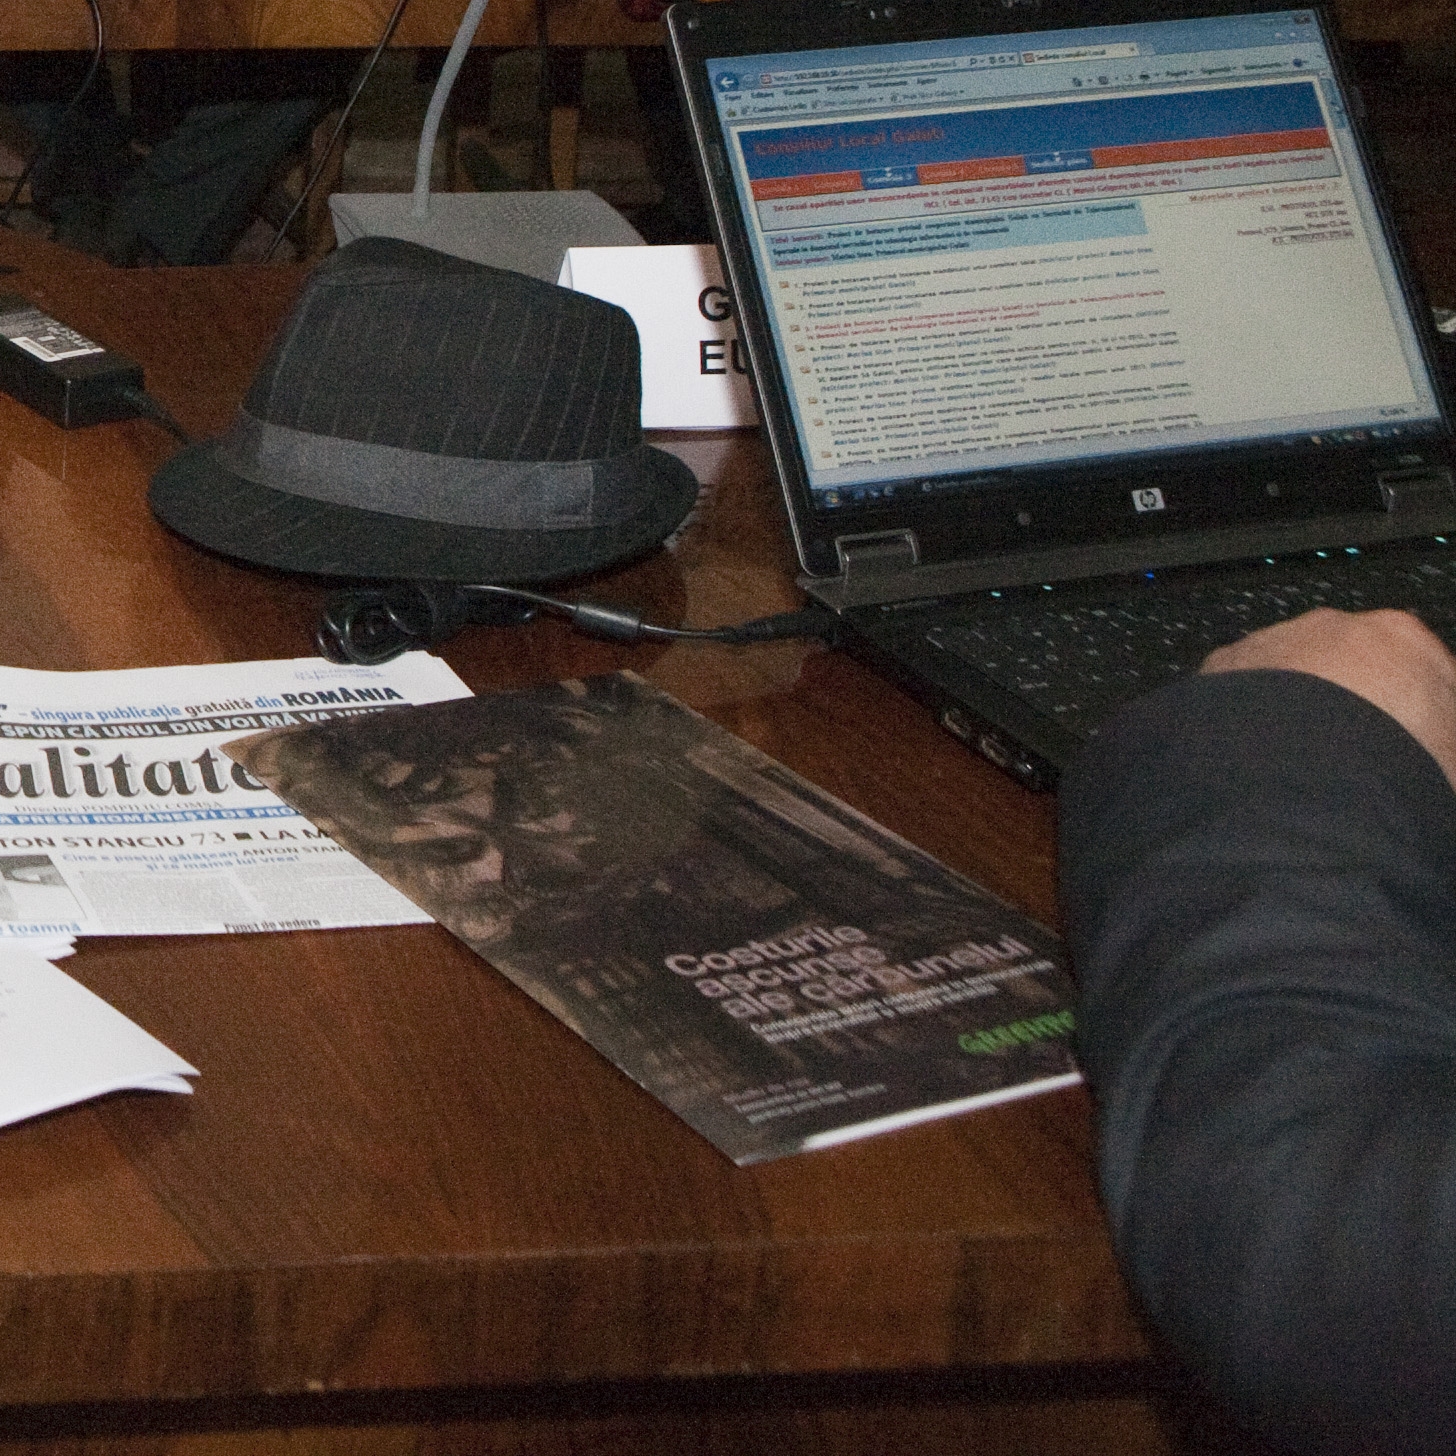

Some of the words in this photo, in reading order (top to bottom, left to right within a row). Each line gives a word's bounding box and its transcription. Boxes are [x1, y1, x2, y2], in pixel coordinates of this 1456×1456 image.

[31, 709, 93, 724] singura
[254, 695, 282, 709] din
[281, 686, 403, 707] ROMÂNIA
[3, 725, 64, 739] SPUN
[67, 722, 98, 739] CĂ
[101, 721, 168, 739] UNUL
[174, 718, 212, 735] DIN
[216, 713, 259, 731] VOI
[63, 835, 184, 849] STANCIU
[259, 829, 296, 841] LA
[242, 846, 298, 857] ANTON
[665, 925, 869, 978] Costurile
[695, 946, 888, 998] ascunse
[722, 990, 794, 1020] ale
